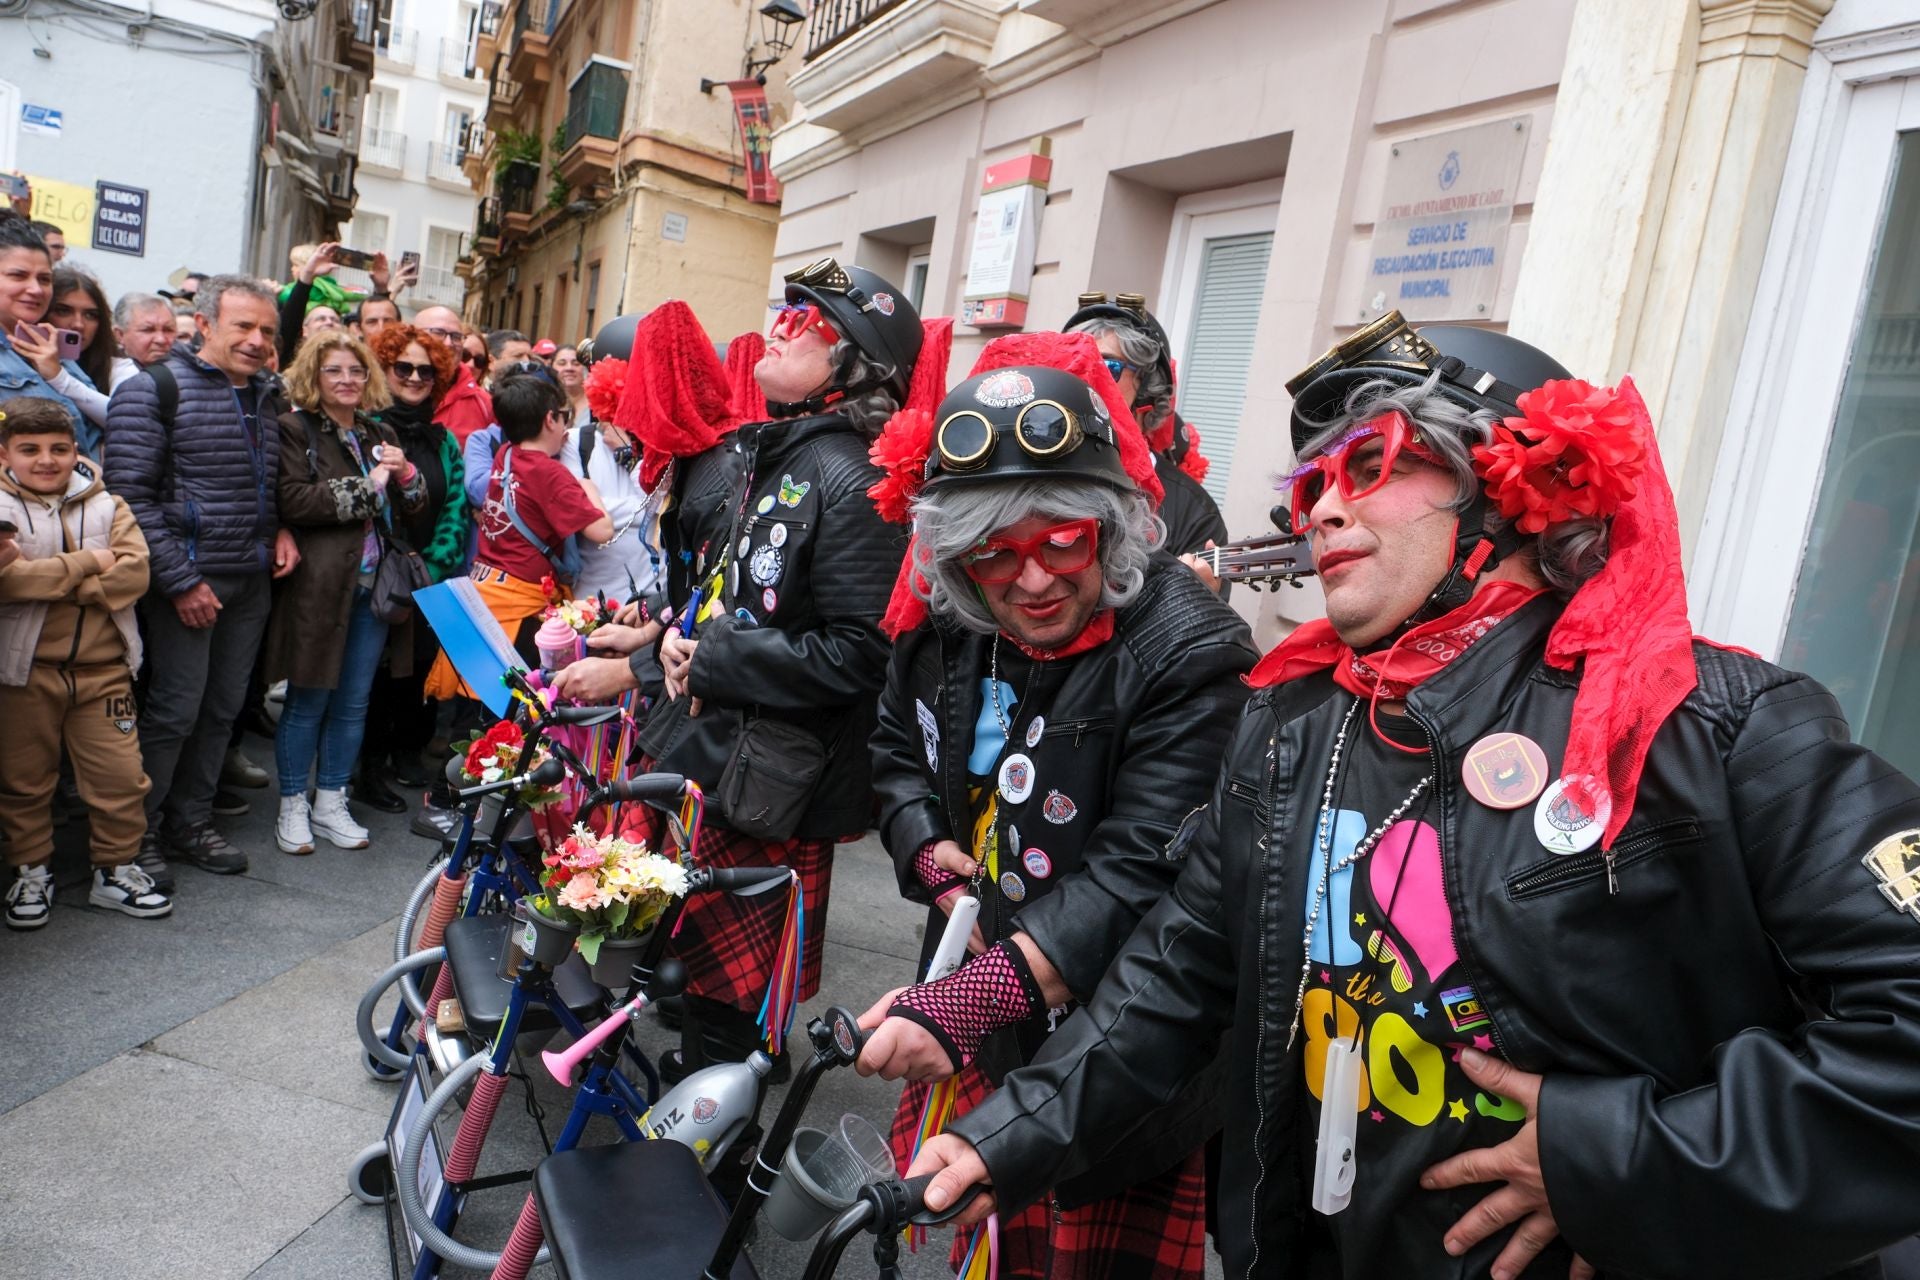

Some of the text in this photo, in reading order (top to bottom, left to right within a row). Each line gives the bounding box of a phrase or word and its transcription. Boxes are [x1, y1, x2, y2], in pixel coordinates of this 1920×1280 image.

[100, 207, 141, 226] GELATO
[98, 225, 140, 249] ICE CREAM
[1407, 221, 1468, 246] SERVICIO DE
[1373, 247, 1495, 275] RECAUDACIÓN EJECUTIVA
[1400, 278, 1450, 298] MUNICIPAL
[1007, 392, 1035, 407] PAVOS
[1546, 810, 1571, 831] WALKING
[1344, 971, 1386, 1007] the
